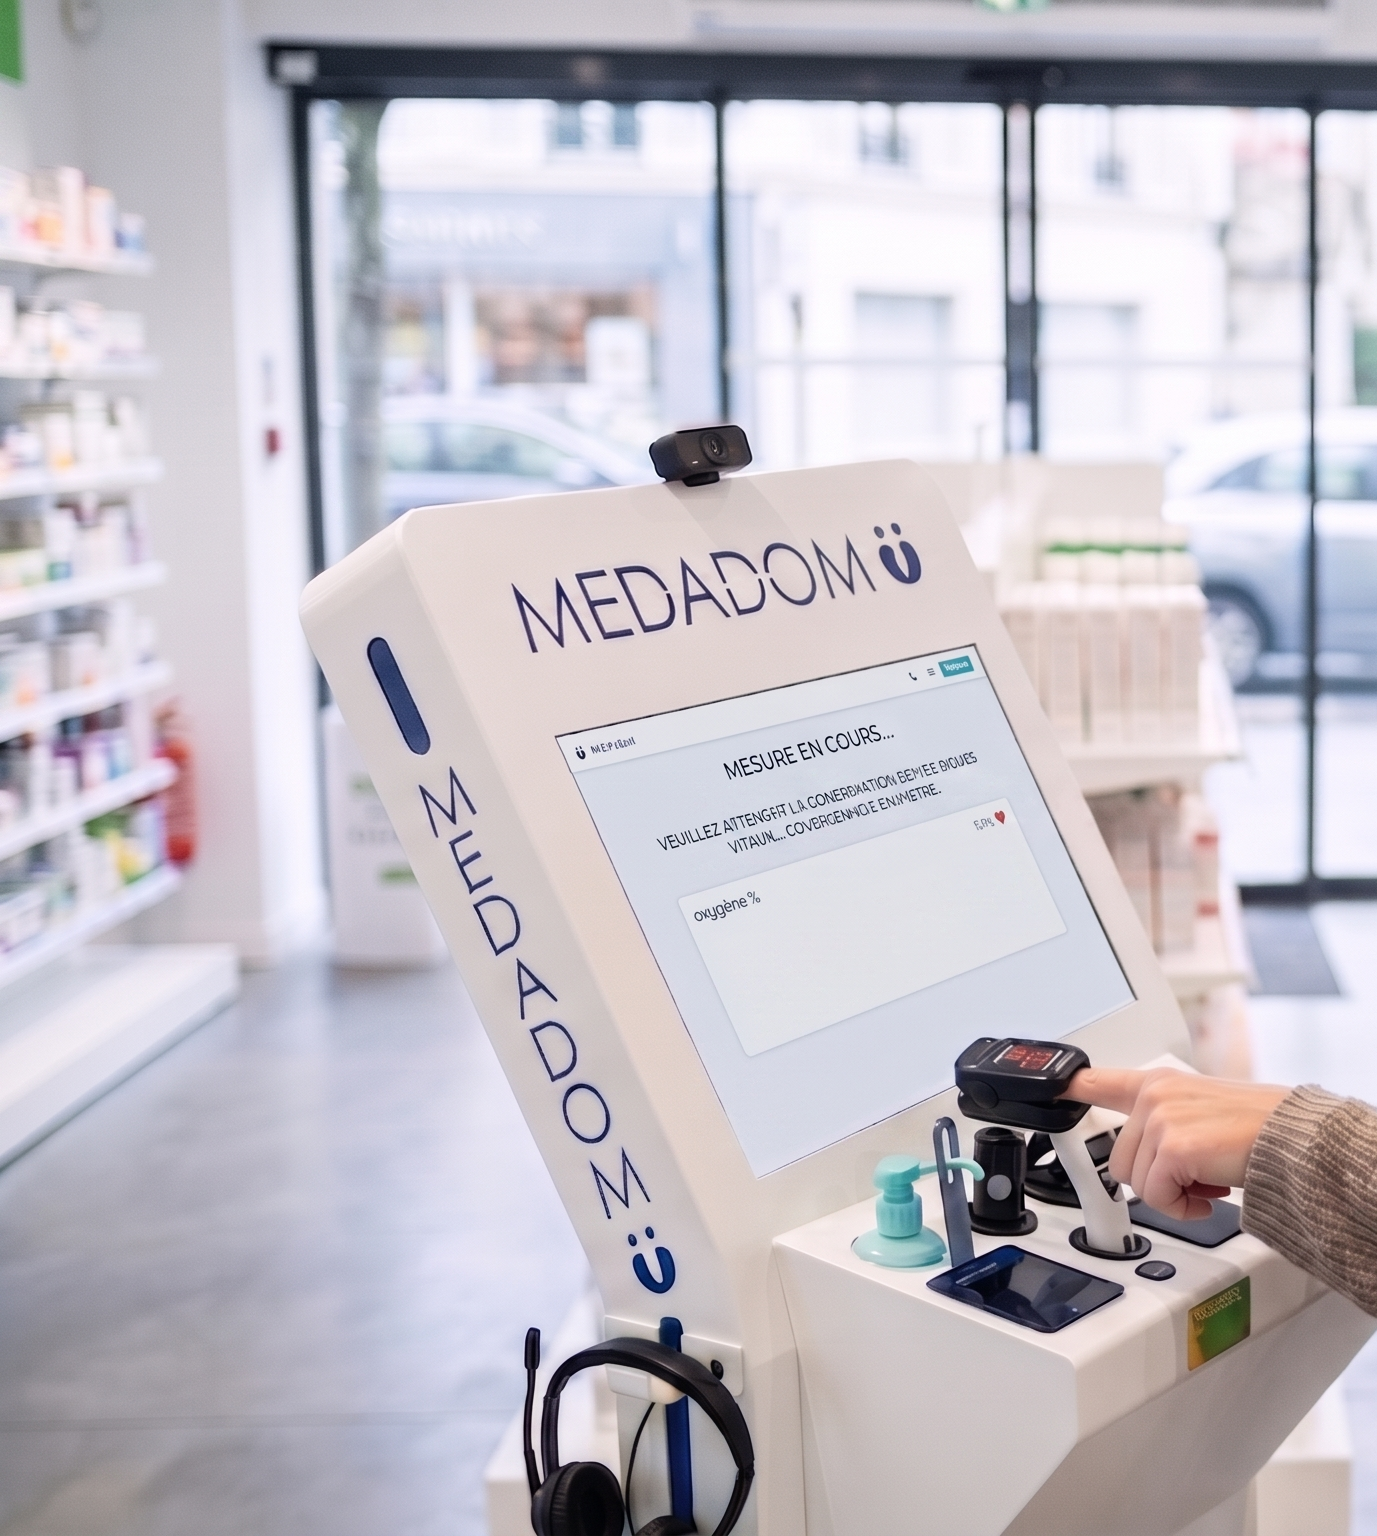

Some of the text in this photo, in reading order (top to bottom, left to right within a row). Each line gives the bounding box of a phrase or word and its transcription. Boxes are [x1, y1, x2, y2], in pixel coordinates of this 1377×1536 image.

[511, 534, 877, 653] MEDADOM
[723, 725, 895, 780] MESURE EN COURS...
[656, 822, 722, 851] VEUILLEZ
[693, 890, 761, 922] oxygène %
[418, 766, 652, 1220] MEDADOM
